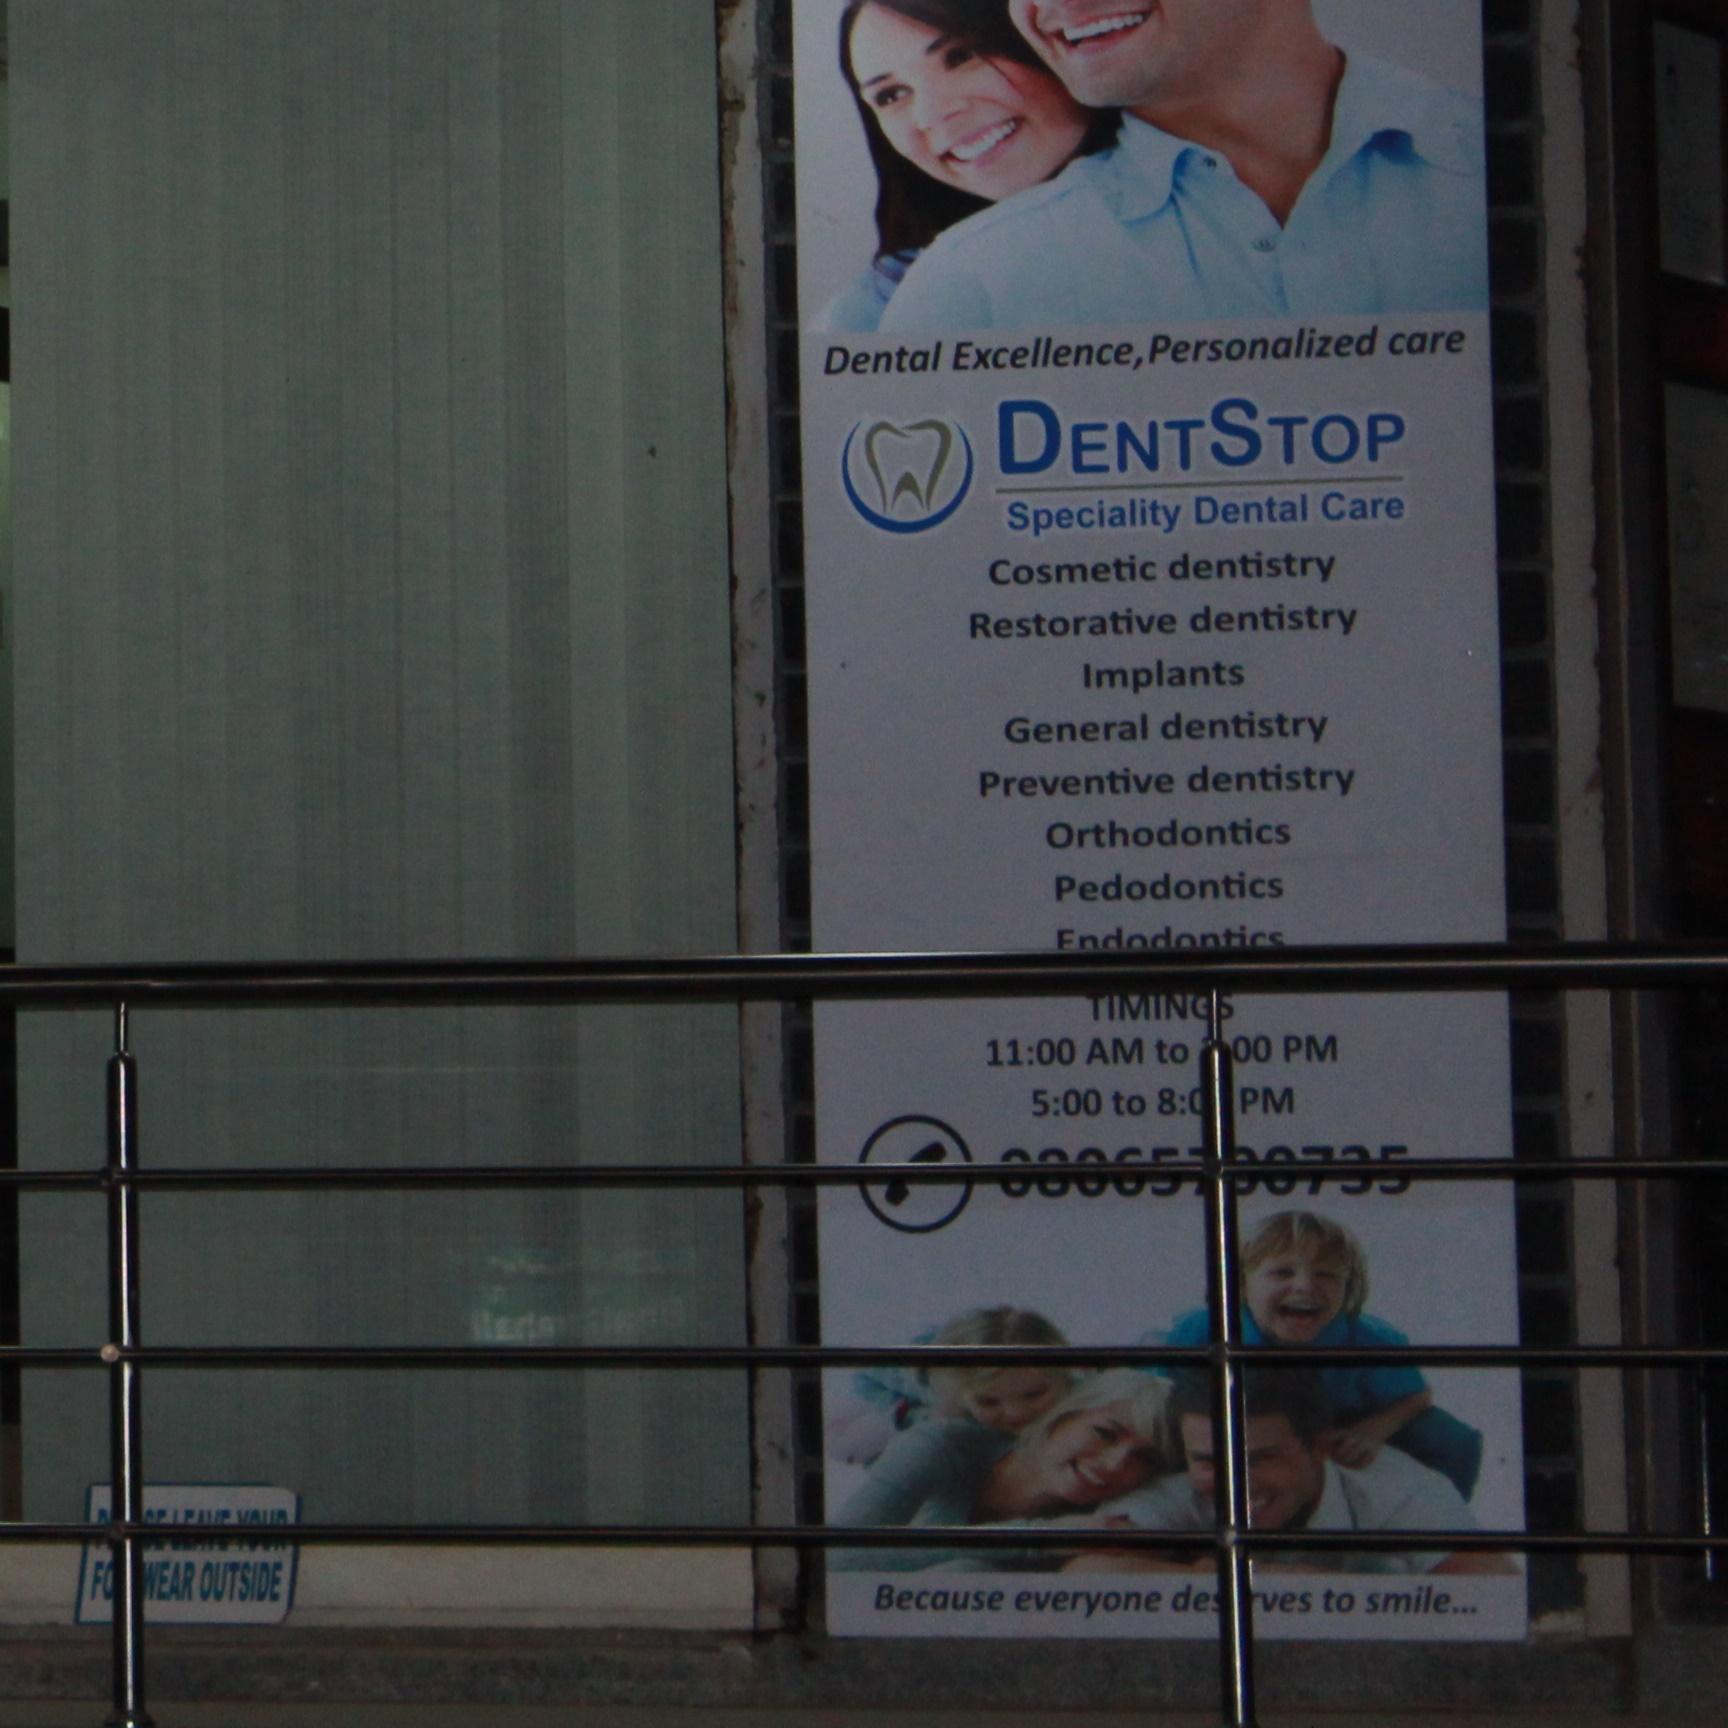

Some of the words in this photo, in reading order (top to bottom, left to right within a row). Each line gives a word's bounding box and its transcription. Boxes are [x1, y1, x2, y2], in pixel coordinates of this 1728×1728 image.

[824, 342, 942, 376] Dental
[1388, 327, 1467, 357] care
[1007, 499, 1183, 538] Speciality
[1195, 493, 1309, 526] Dental
[1320, 490, 1406, 522] Care
[987, 553, 1158, 587] Cosmetic
[1168, 551, 1336, 587] dentistry
[968, 609, 1179, 640] Restorative
[1189, 603, 1359, 637] dentistry
[1082, 658, 1246, 695] Implants
[1003, 713, 1149, 746] General
[1160, 711, 1329, 745] dentistry
[978, 768, 1176, 799] Preventive
[1186, 762, 1356, 797] dentistry
[1045, 819, 1292, 852] Orthodontics
[1054, 872, 1285, 904] Pedodontics
[985, 1037, 1076, 1067] 11:00
[1085, 1037, 1144, 1066] AM
[1155, 1039, 1190, 1065] to
[1202, 1036, 1272, 1064] 00
[1282, 1035, 1339, 1063] PM
[1030, 1088, 1103, 1118] 5:00
[1112, 1090, 1146, 1117] to
[1156, 1088, 1224, 1116] 8:0
[1239, 1086, 1295, 1116] PM
[90, 1560, 194, 1602] FOWEAR
[200, 1560, 284, 1602] OUTSIDE
[873, 1582, 1005, 1615] Because
[1013, 1587, 1162, 1620] everyone
[1170, 1584, 1314, 1615] desves
[1322, 1587, 1357, 1615] to
[1364, 1583, 1480, 1617] smile...
